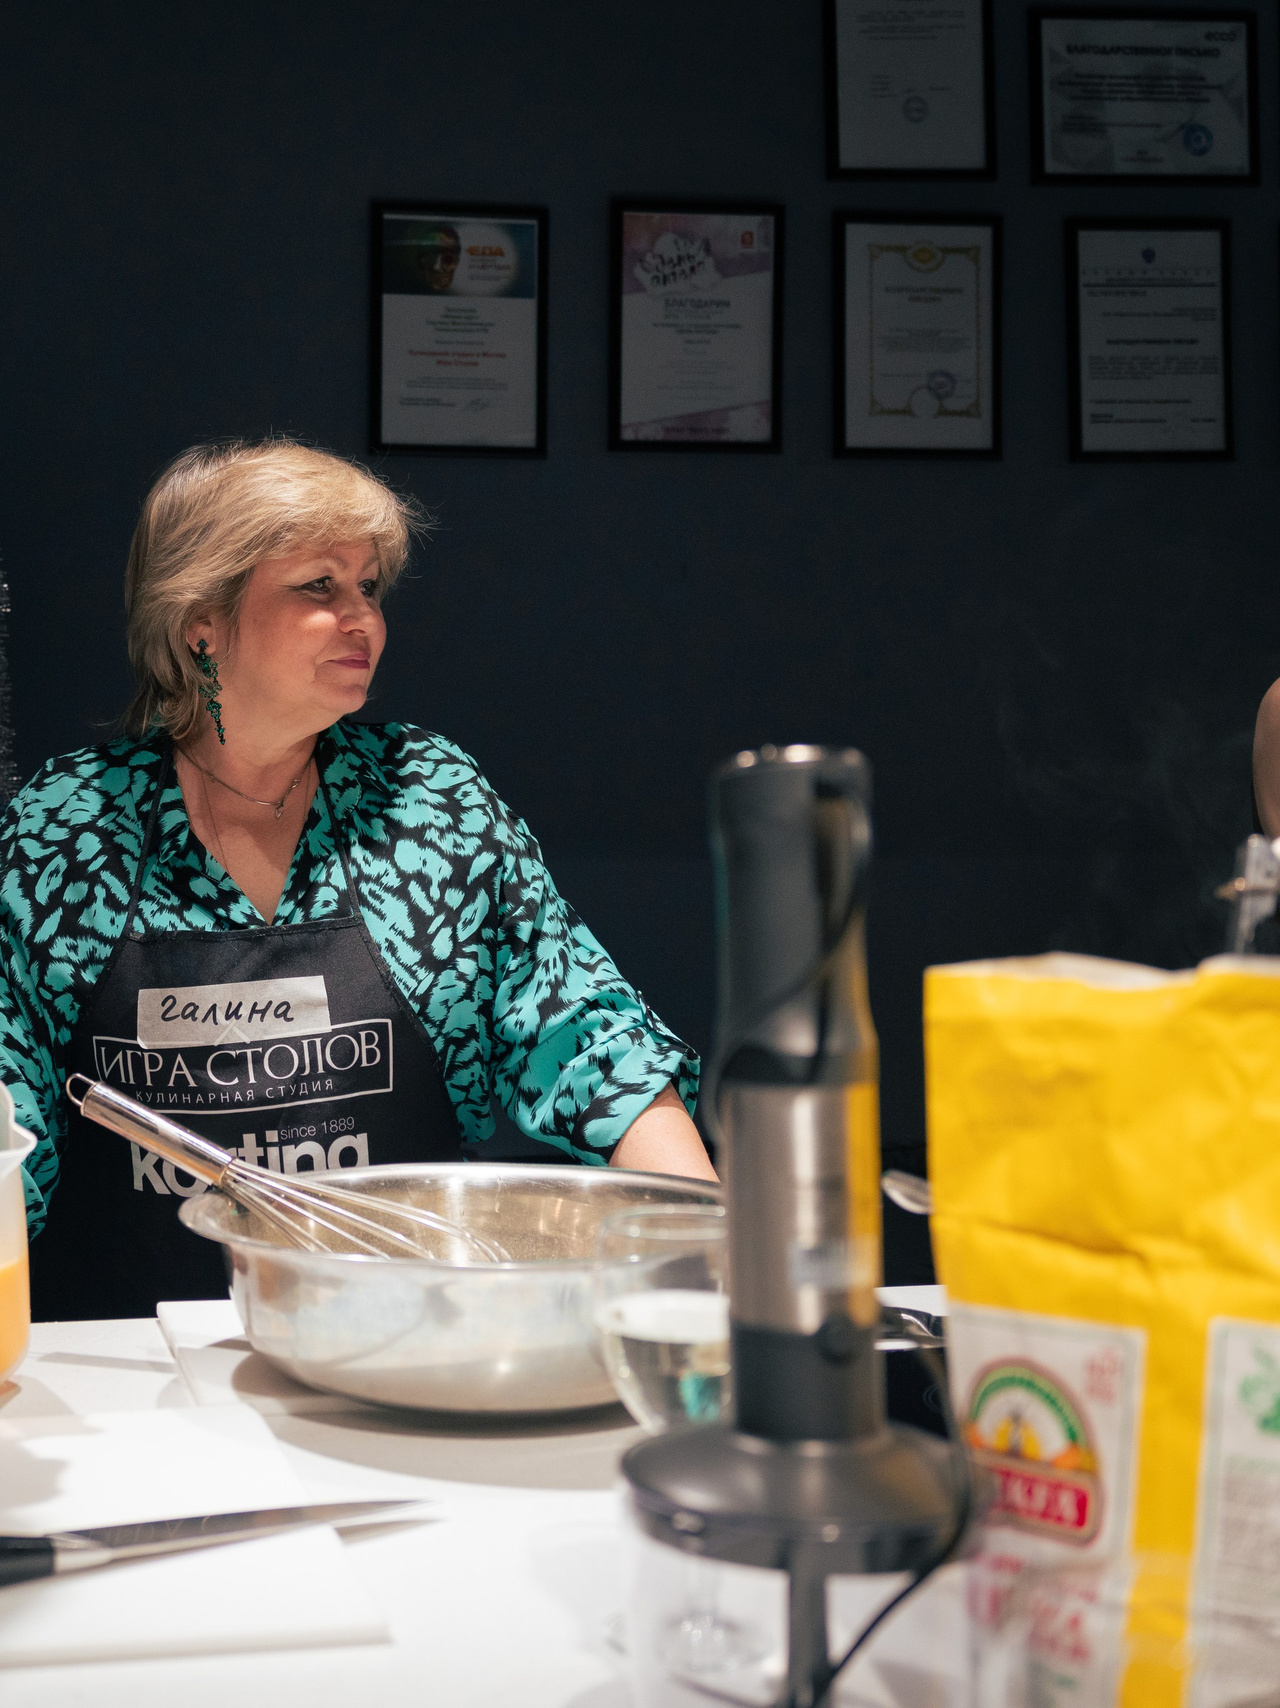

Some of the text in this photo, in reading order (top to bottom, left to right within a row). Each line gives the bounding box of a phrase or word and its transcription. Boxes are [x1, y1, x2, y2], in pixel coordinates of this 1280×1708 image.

[100, 1030, 381, 1087] ИГРА СТОЛОВ
[135, 1078, 334, 1104] КУЛИНАРНАЯ СТУДИЯ
[280, 1116, 355, 1141] since 1889
